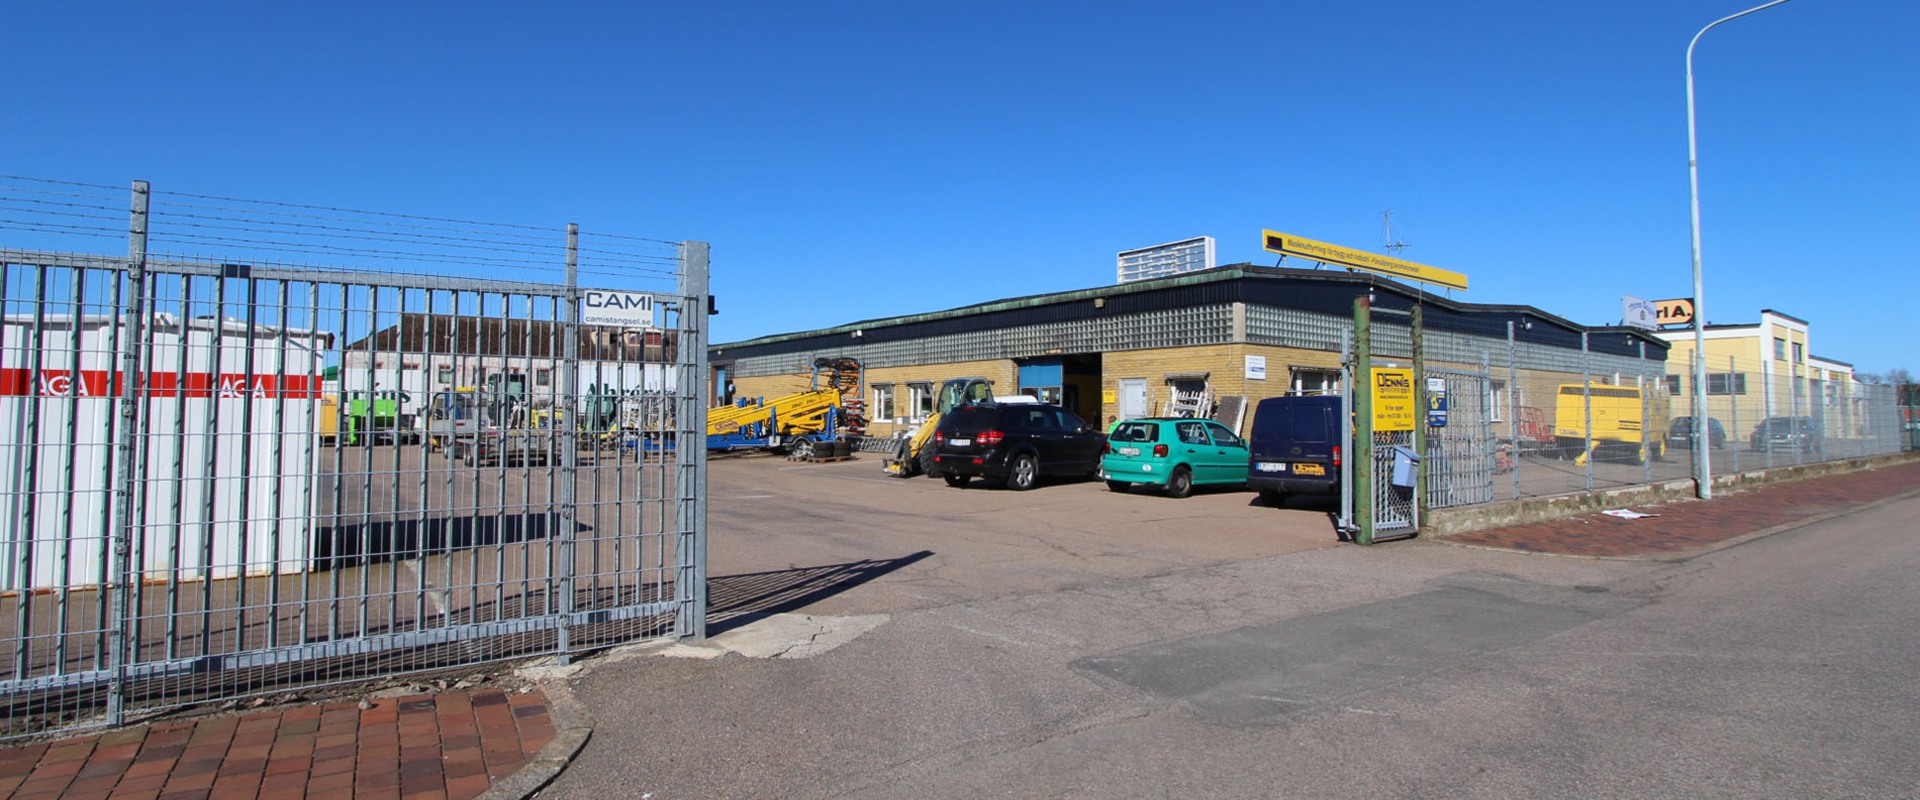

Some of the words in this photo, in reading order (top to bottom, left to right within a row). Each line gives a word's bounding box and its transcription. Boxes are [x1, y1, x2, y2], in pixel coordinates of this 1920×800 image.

[586, 291, 652, 311] CAMI
[585, 315, 651, 326] camistangsel.se
[219, 375, 267, 399] AGA
